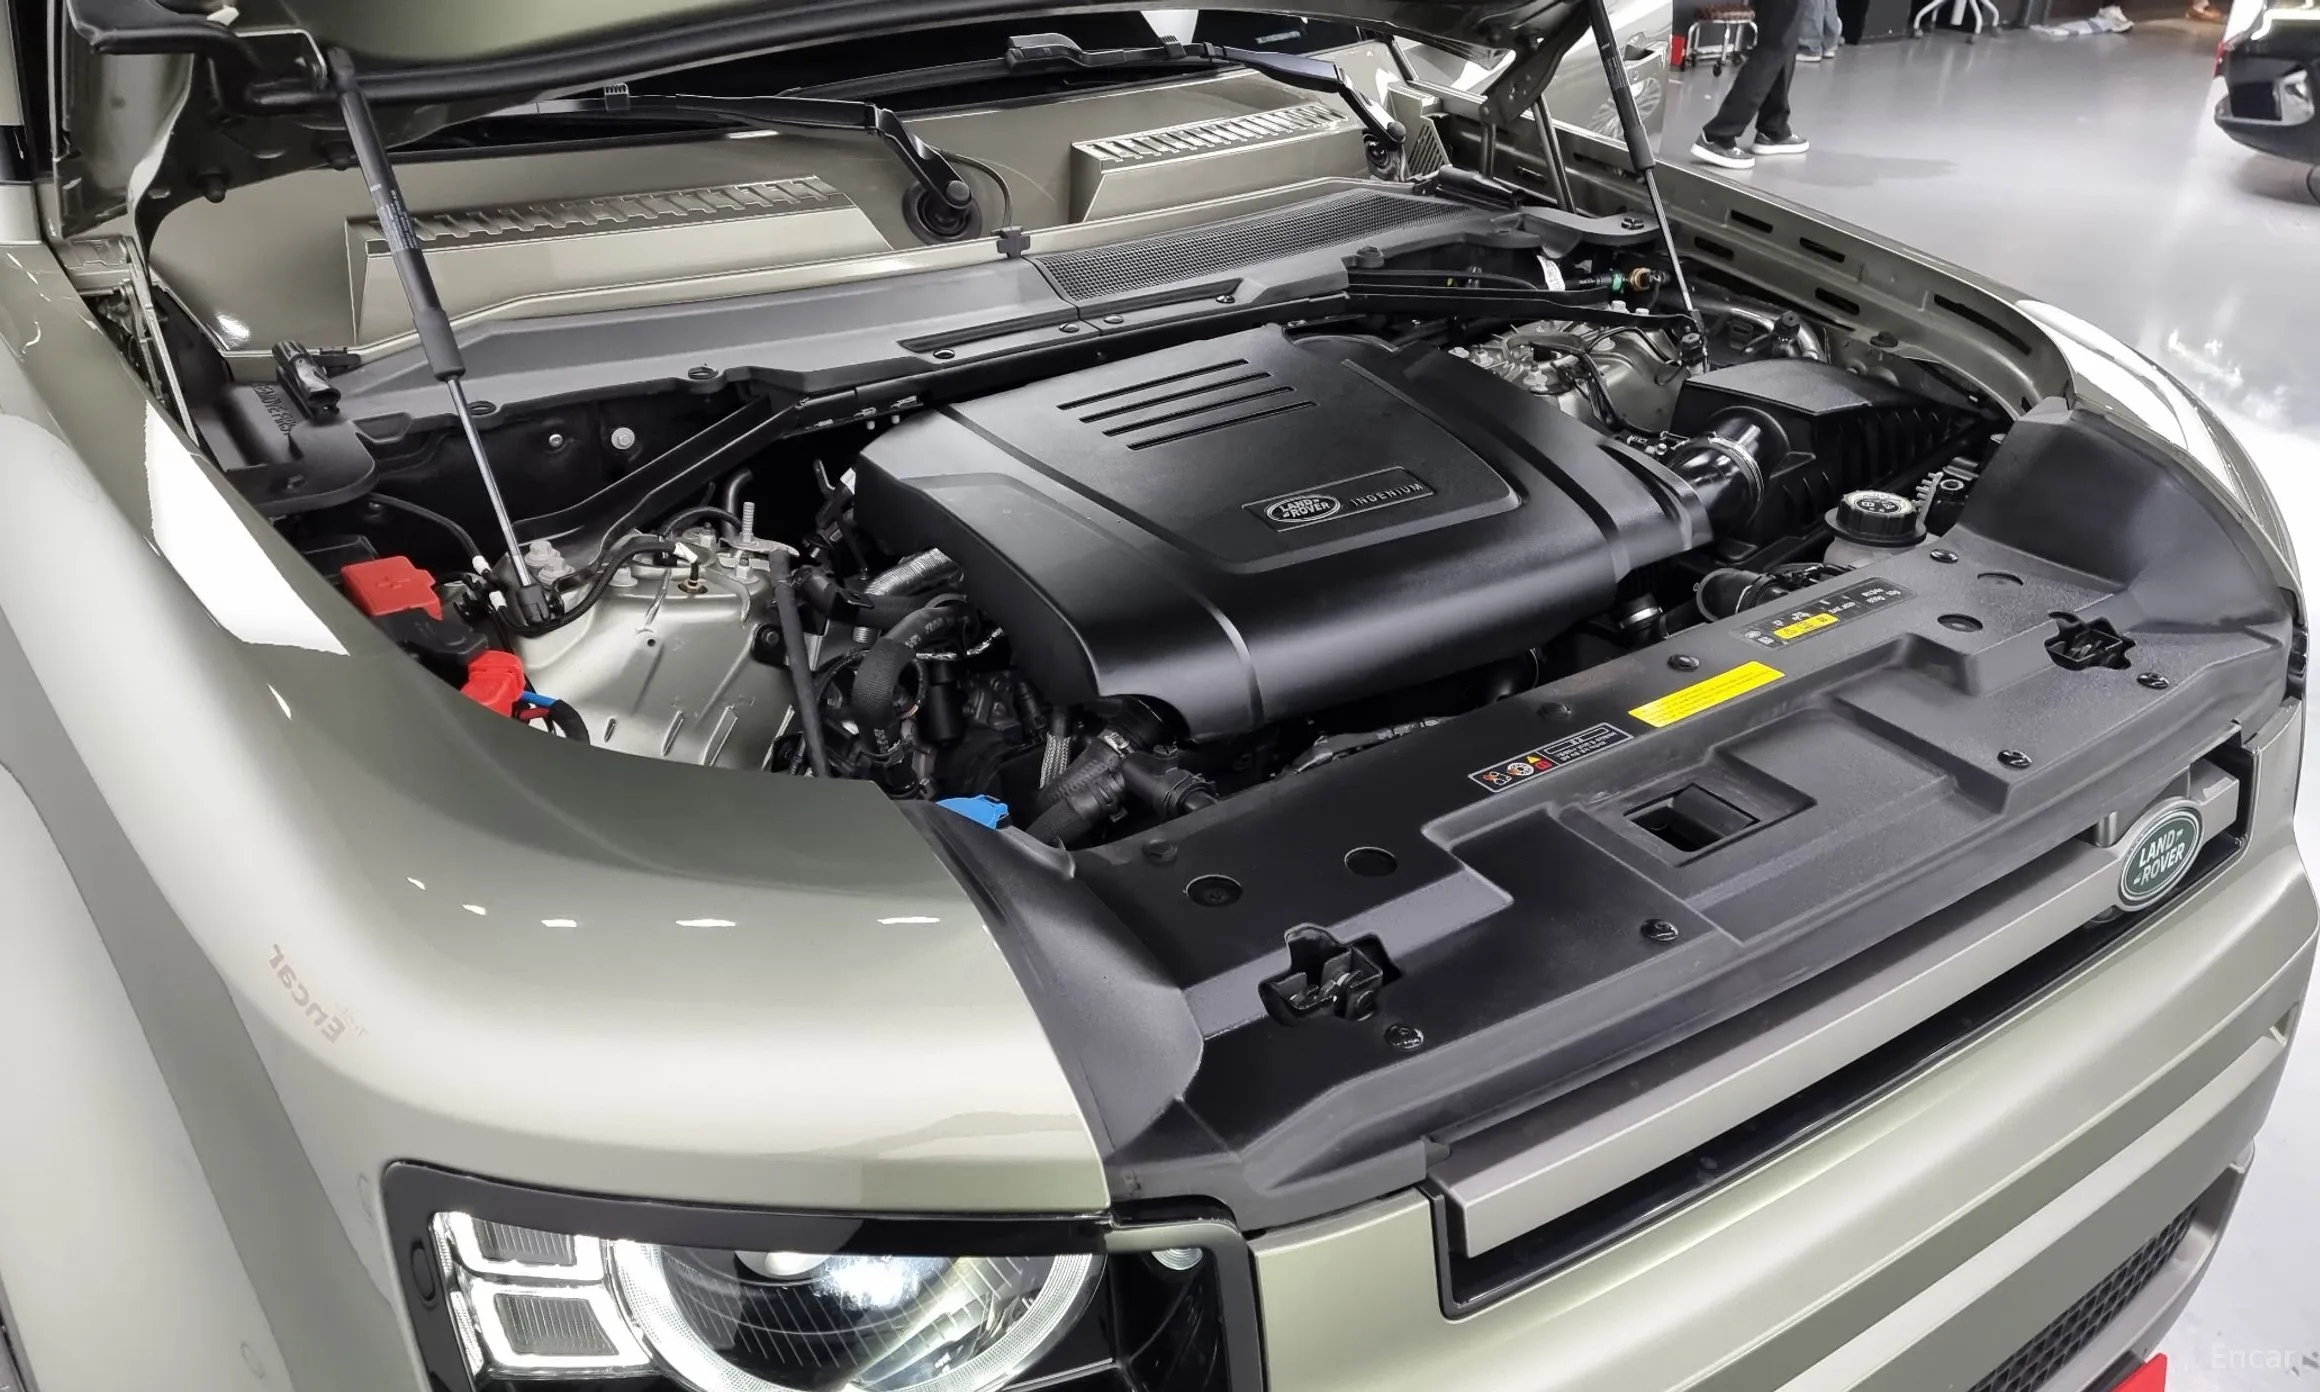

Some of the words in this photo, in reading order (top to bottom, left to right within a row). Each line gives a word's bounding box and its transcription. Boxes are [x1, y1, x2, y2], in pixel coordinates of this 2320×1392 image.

[1280, 499, 1314, 512] LAND
[1350, 482, 1424, 507] INGENIUM
[1291, 501, 1330, 518] ROVER
[2138, 829, 2176, 869] LAND
[2141, 842, 2186, 886] ROVER
